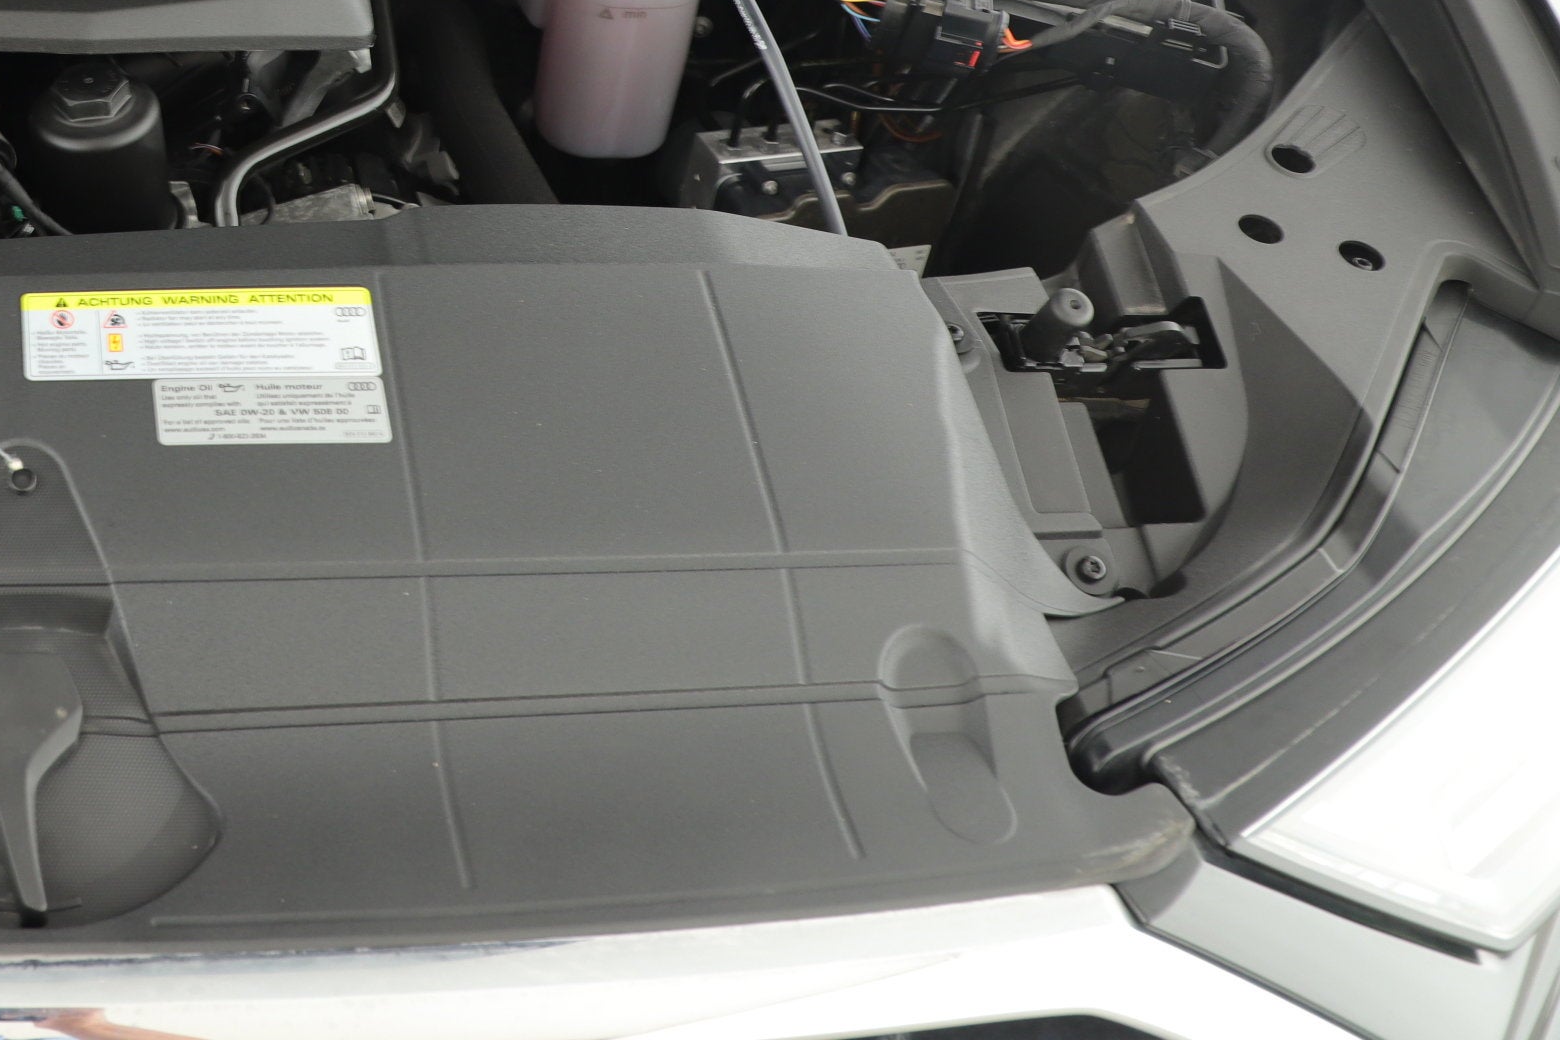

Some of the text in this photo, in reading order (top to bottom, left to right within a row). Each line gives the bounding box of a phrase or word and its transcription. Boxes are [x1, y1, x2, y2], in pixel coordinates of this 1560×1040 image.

[77, 293, 334, 307] ACHTUNG WARNING ATTENTION
[161, 385, 196, 393] Engine
